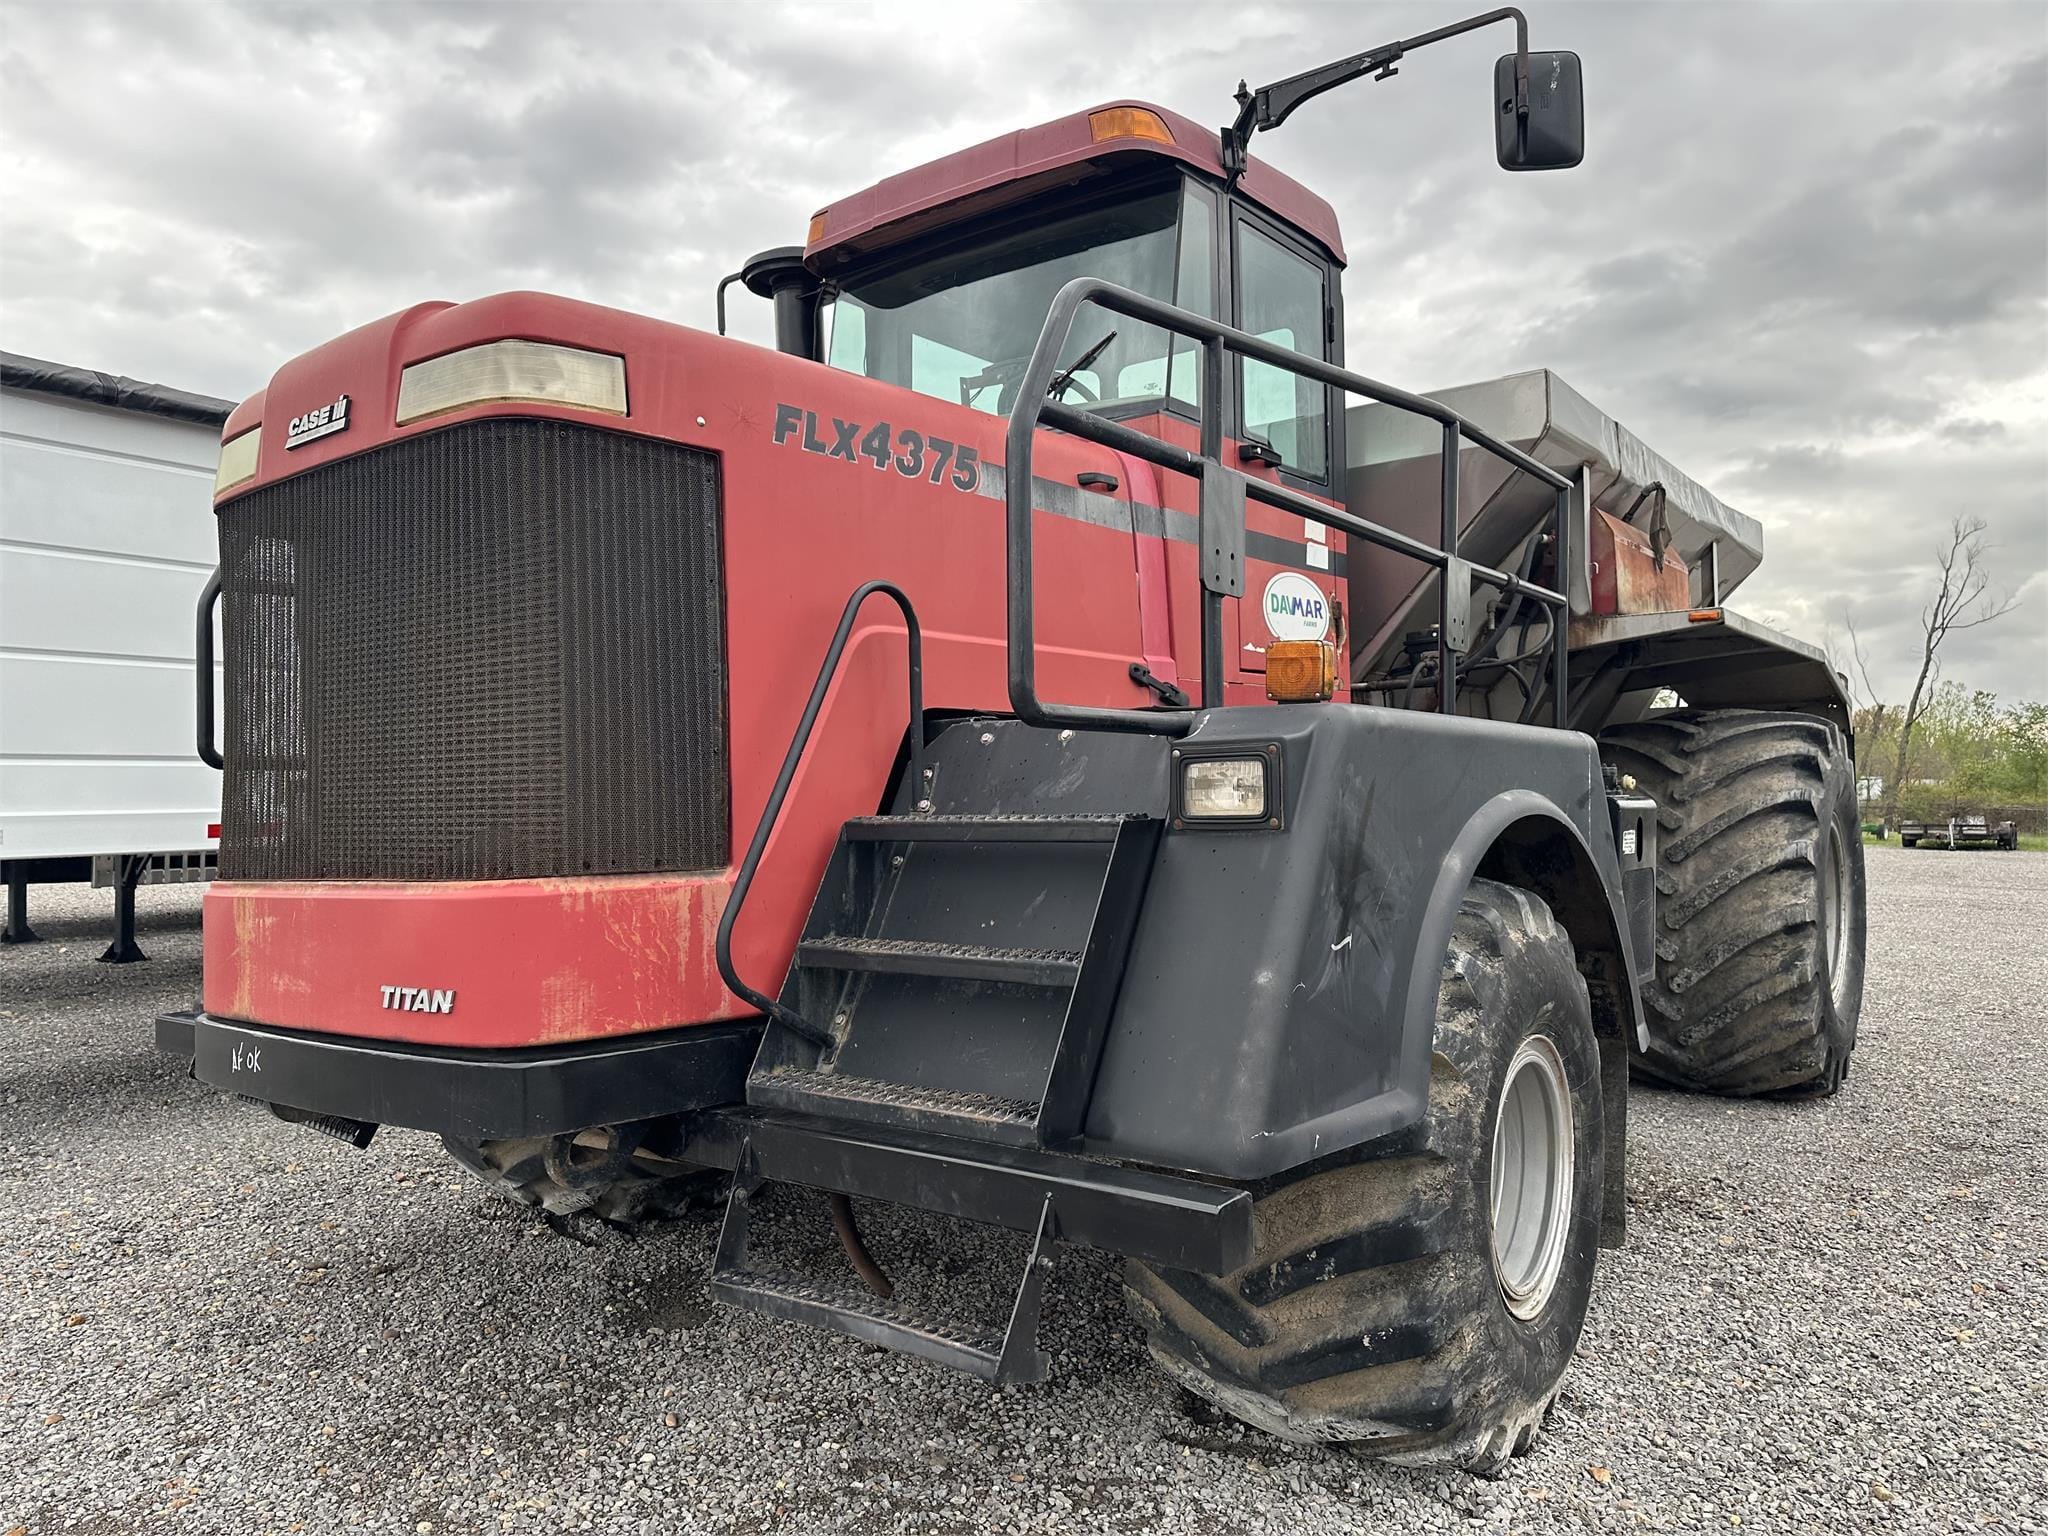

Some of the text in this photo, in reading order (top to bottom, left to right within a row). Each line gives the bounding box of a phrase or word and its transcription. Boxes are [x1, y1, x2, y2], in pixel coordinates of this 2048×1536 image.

[288, 405, 331, 437] CASE
[772, 402, 981, 493] FLX4375
[1270, 592, 1324, 620] DAVMAR
[380, 985, 455, 1014] TITAN
